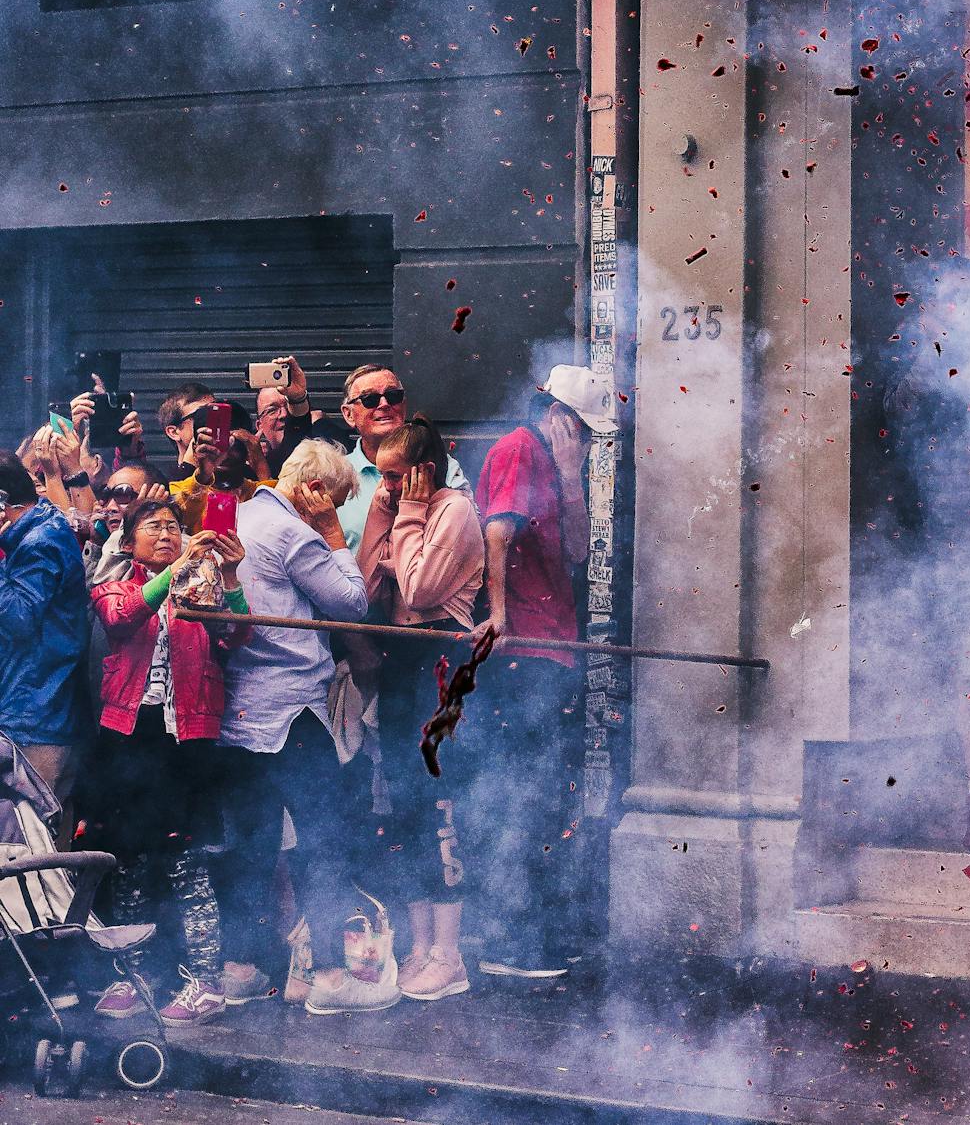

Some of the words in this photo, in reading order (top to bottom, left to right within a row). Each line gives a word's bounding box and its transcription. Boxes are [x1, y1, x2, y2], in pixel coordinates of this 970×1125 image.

[593, 158, 614, 172] NICK
[594, 242, 616, 253] PRED
[594, 252, 617, 263] ITEMS
[593, 274, 616, 291] SAVE
[660, 305, 722, 340] 235
